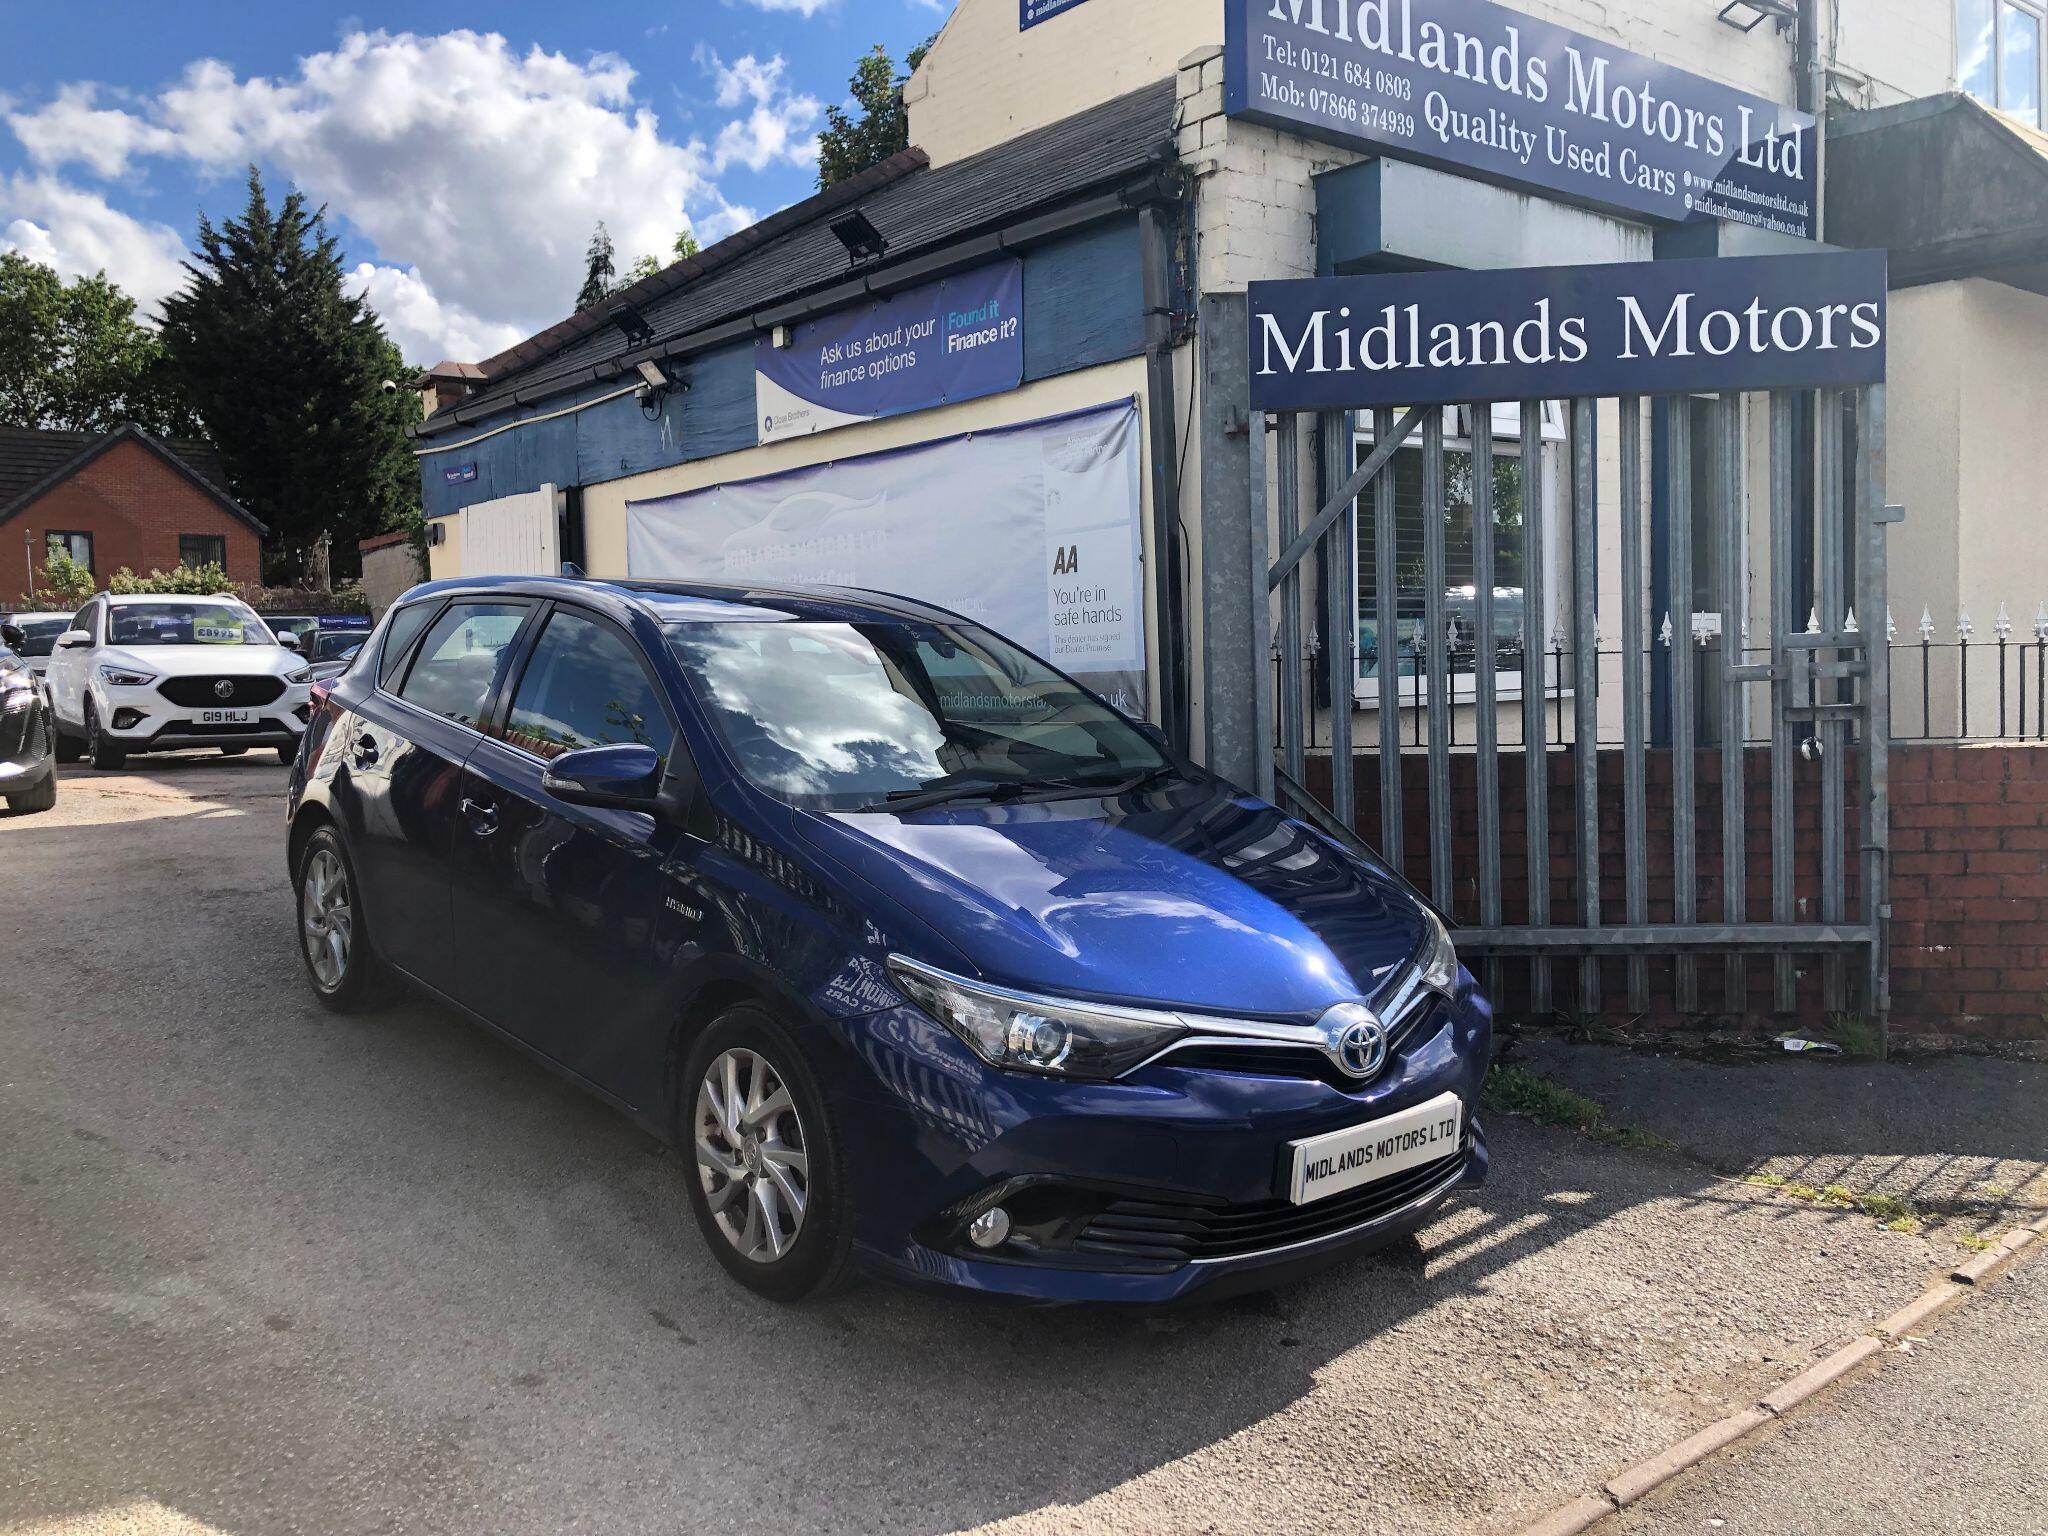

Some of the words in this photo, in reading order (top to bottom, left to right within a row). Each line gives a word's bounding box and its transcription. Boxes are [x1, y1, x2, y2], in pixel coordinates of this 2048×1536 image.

[1262, 33, 1298, 68] Tel:
[1301, 47, 1339, 80] 0121
[1343, 60, 1372, 90] 684
[1375, 70, 1412, 101] 0803
[1260, 71, 1305, 108] Mob:
[1309, 87, 1357, 122] 07866
[1361, 102, 1415, 138] 374939
[1564, 46, 1724, 157] Motors
[1737, 104, 1804, 180] Ltd
[1424, 90, 1538, 165] Quality
[1544, 124, 1612, 179] Used
[1619, 148, 1676, 196] Cars
[1693, 174, 1809, 217] www.midlandsmotorsltd.co.uk
[1694, 195, 1807, 238] midlandsmotors@yahoo.co.uk
[948, 325, 998, 354] Finance
[1000, 316, 1018, 340] it?
[949, 308, 987, 330] Found
[989, 299, 1000, 318] it
[1256, 298, 1588, 375] Midlands
[1616, 293, 1881, 360] Motors
[820, 342, 844, 366] Ask
[846, 340, 862, 358] us
[865, 326, 902, 354] about
[905, 318, 936, 347] your
[820, 364, 866, 390] finance
[868, 350, 916, 381] options
[1052, 544, 1079, 575] AA
[1053, 586, 1092, 605] You're
[1094, 584, 1107, 602] in
[1054, 607, 1080, 626] safe
[1082, 604, 1122, 625] hands
[203, 711, 222, 722] G19
[224, 711, 248, 722] HLJ
[1305, 1145, 1373, 1183] MIDLANDS
[1376, 1127, 1427, 1160] MOTORS
[1429, 1118, 1454, 1143] LTD
